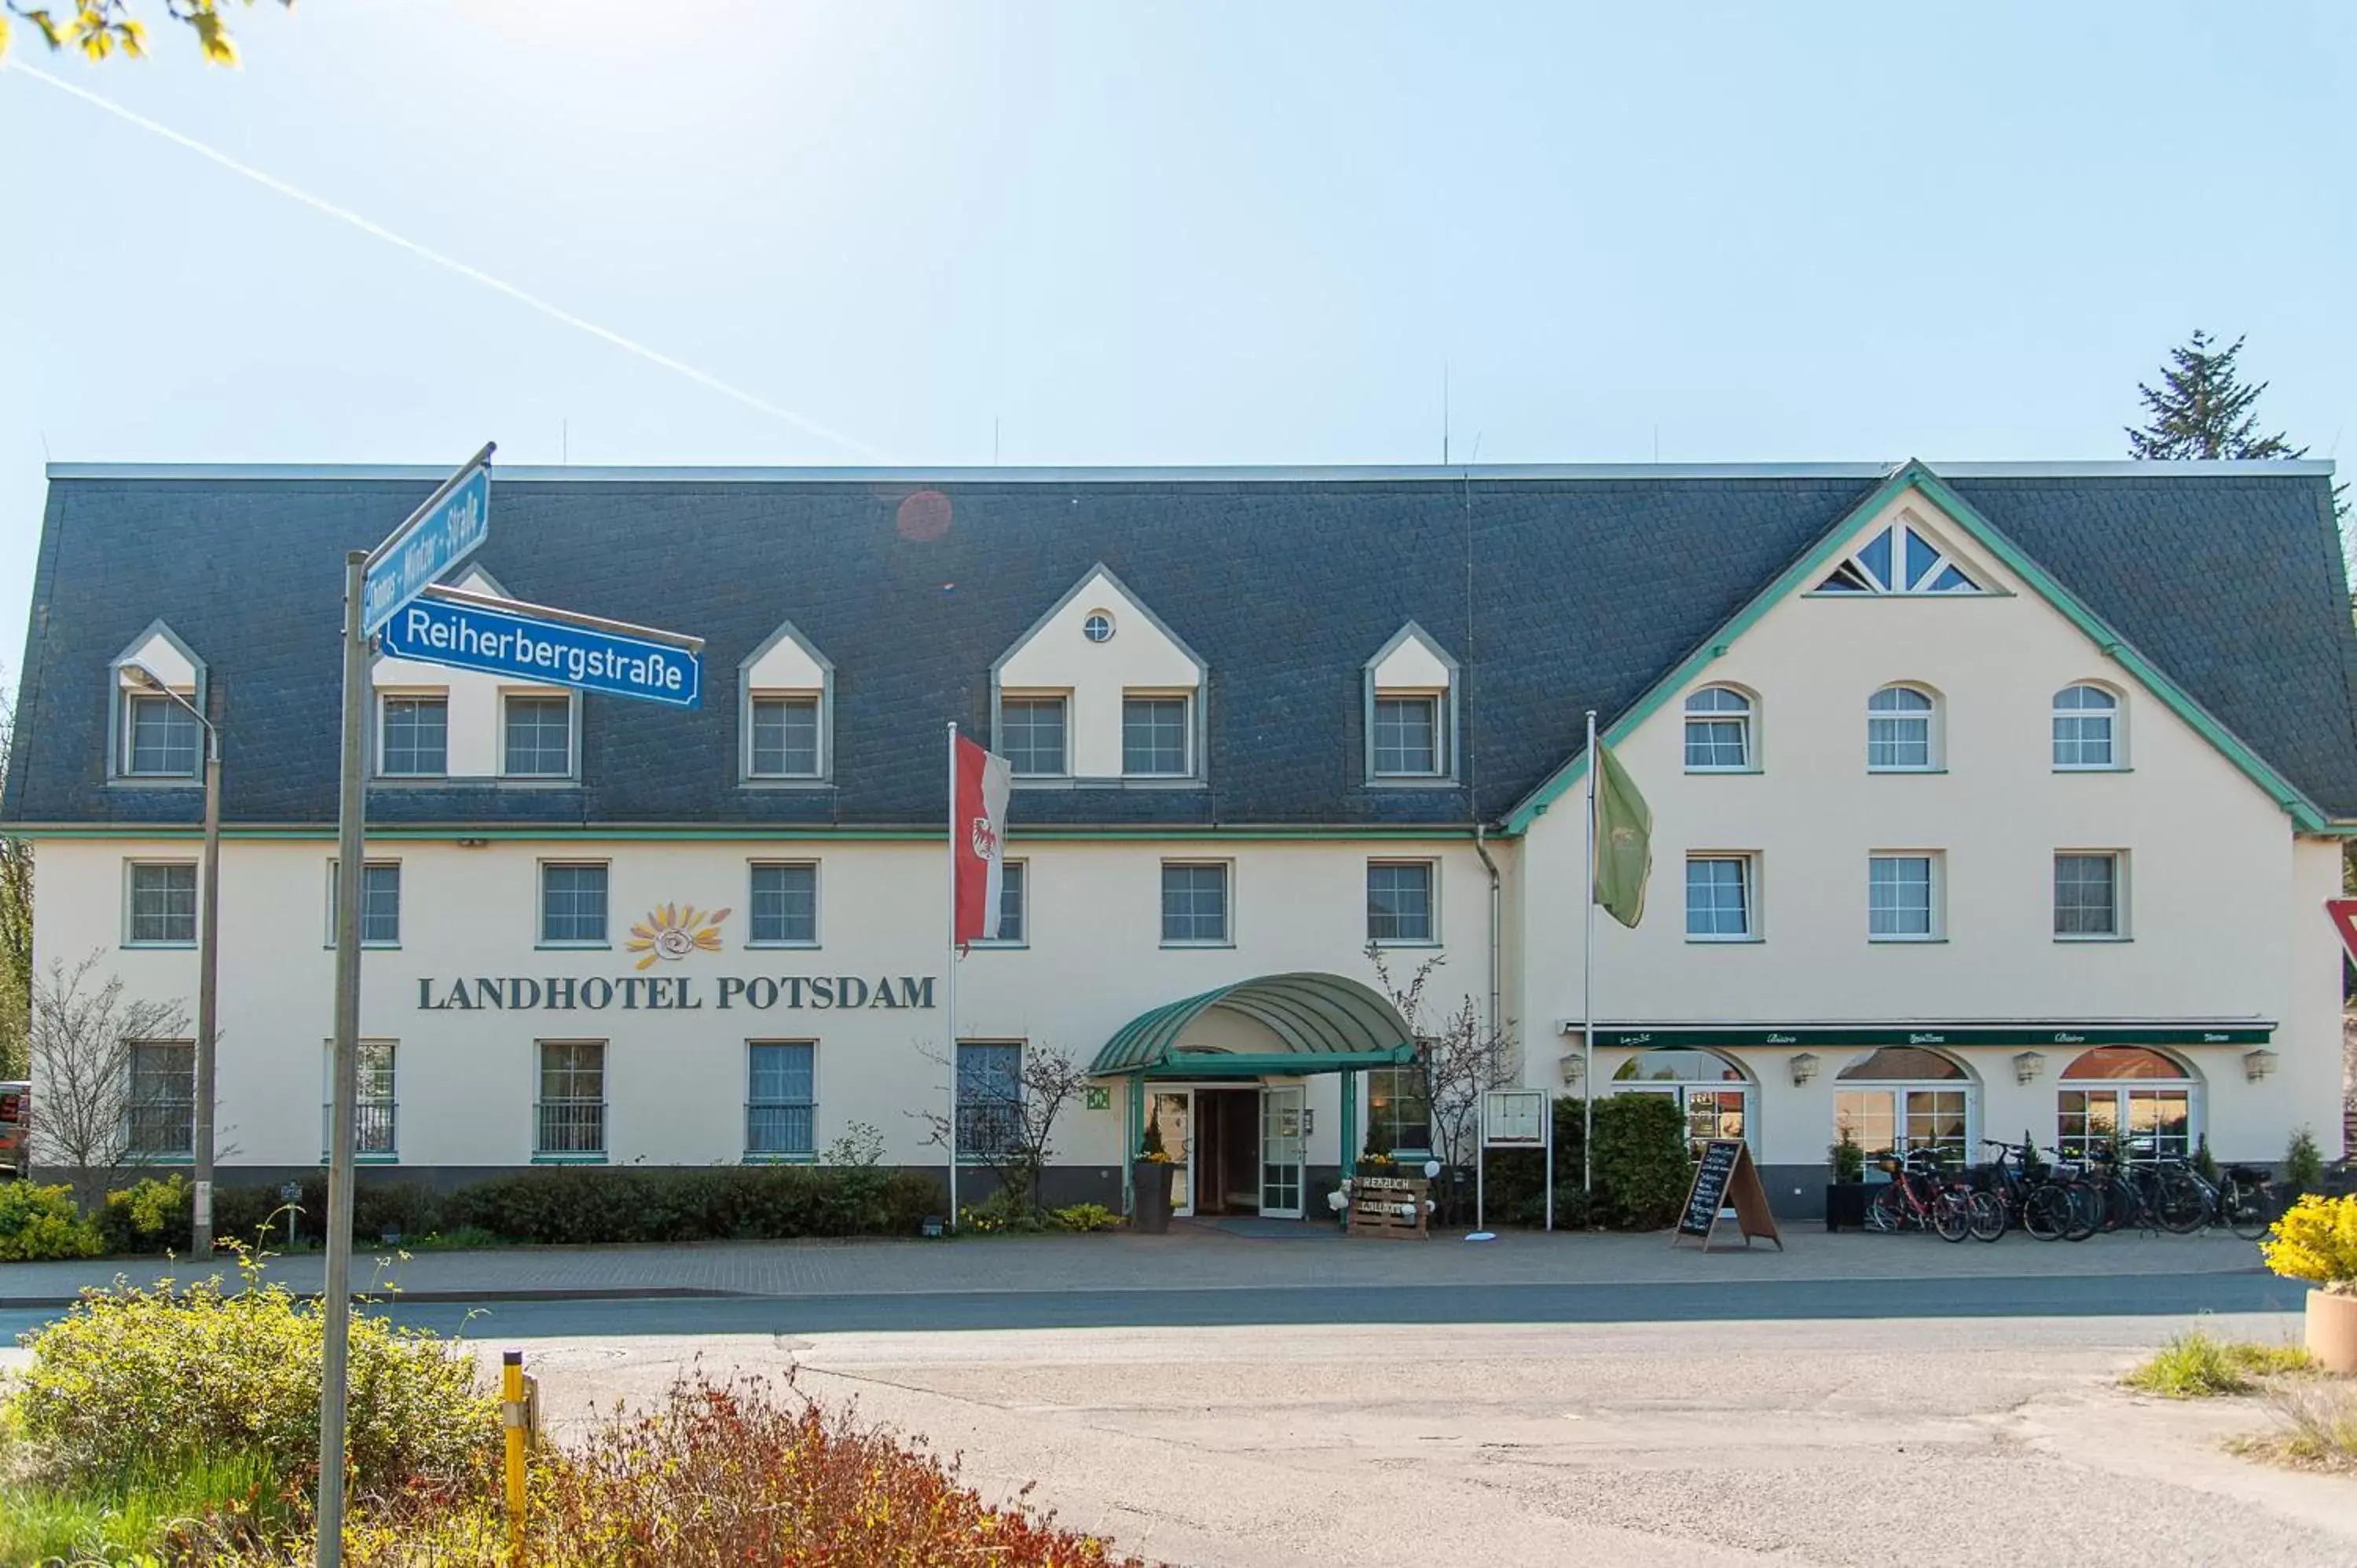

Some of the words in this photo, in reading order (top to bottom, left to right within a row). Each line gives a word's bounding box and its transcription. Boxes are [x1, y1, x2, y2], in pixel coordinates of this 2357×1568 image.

[406, 608, 683, 690] Reiherbergstraße
[417, 977, 702, 1009] LANDHOTEL
[716, 976, 937, 1009] POTSDAM
